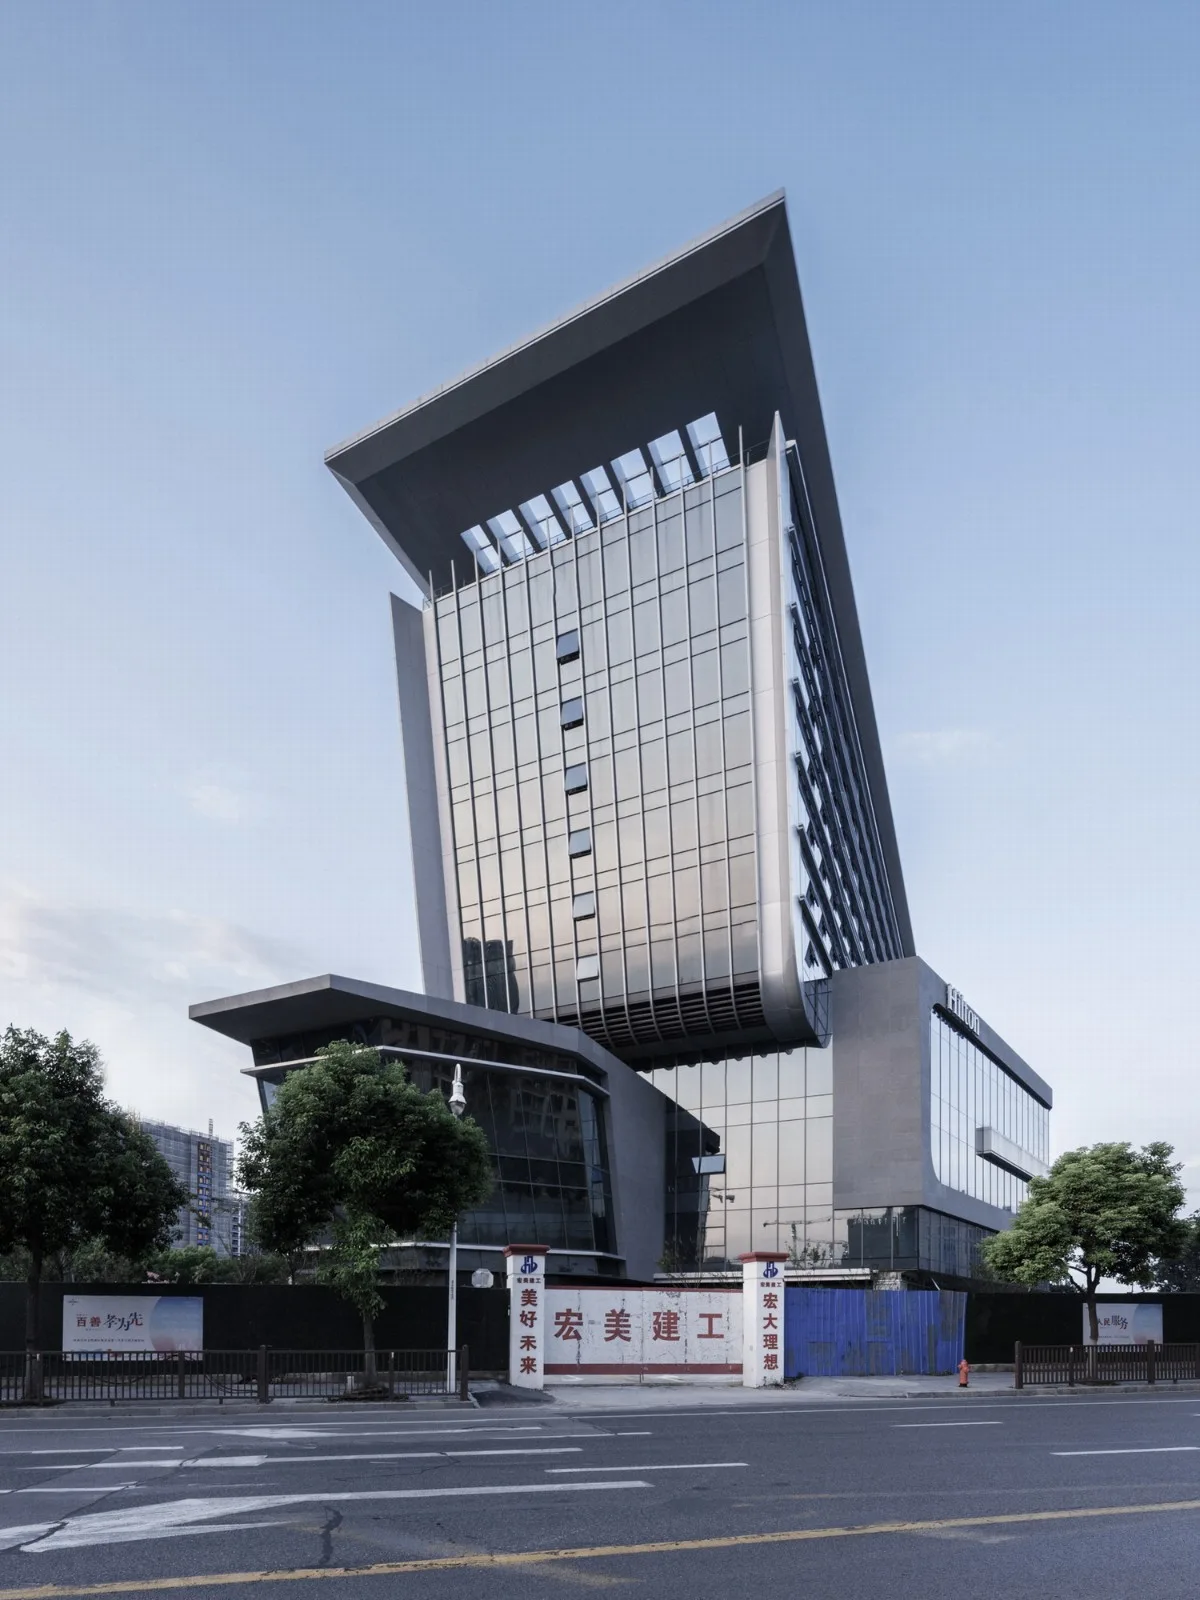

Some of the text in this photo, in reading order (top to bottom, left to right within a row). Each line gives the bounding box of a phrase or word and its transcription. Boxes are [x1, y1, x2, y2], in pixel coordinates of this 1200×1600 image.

[946, 983, 980, 1036] Hilton
[554, 1308, 725, 1343] 宏美建工
[762, 1292, 779, 1370] 宏大理想
